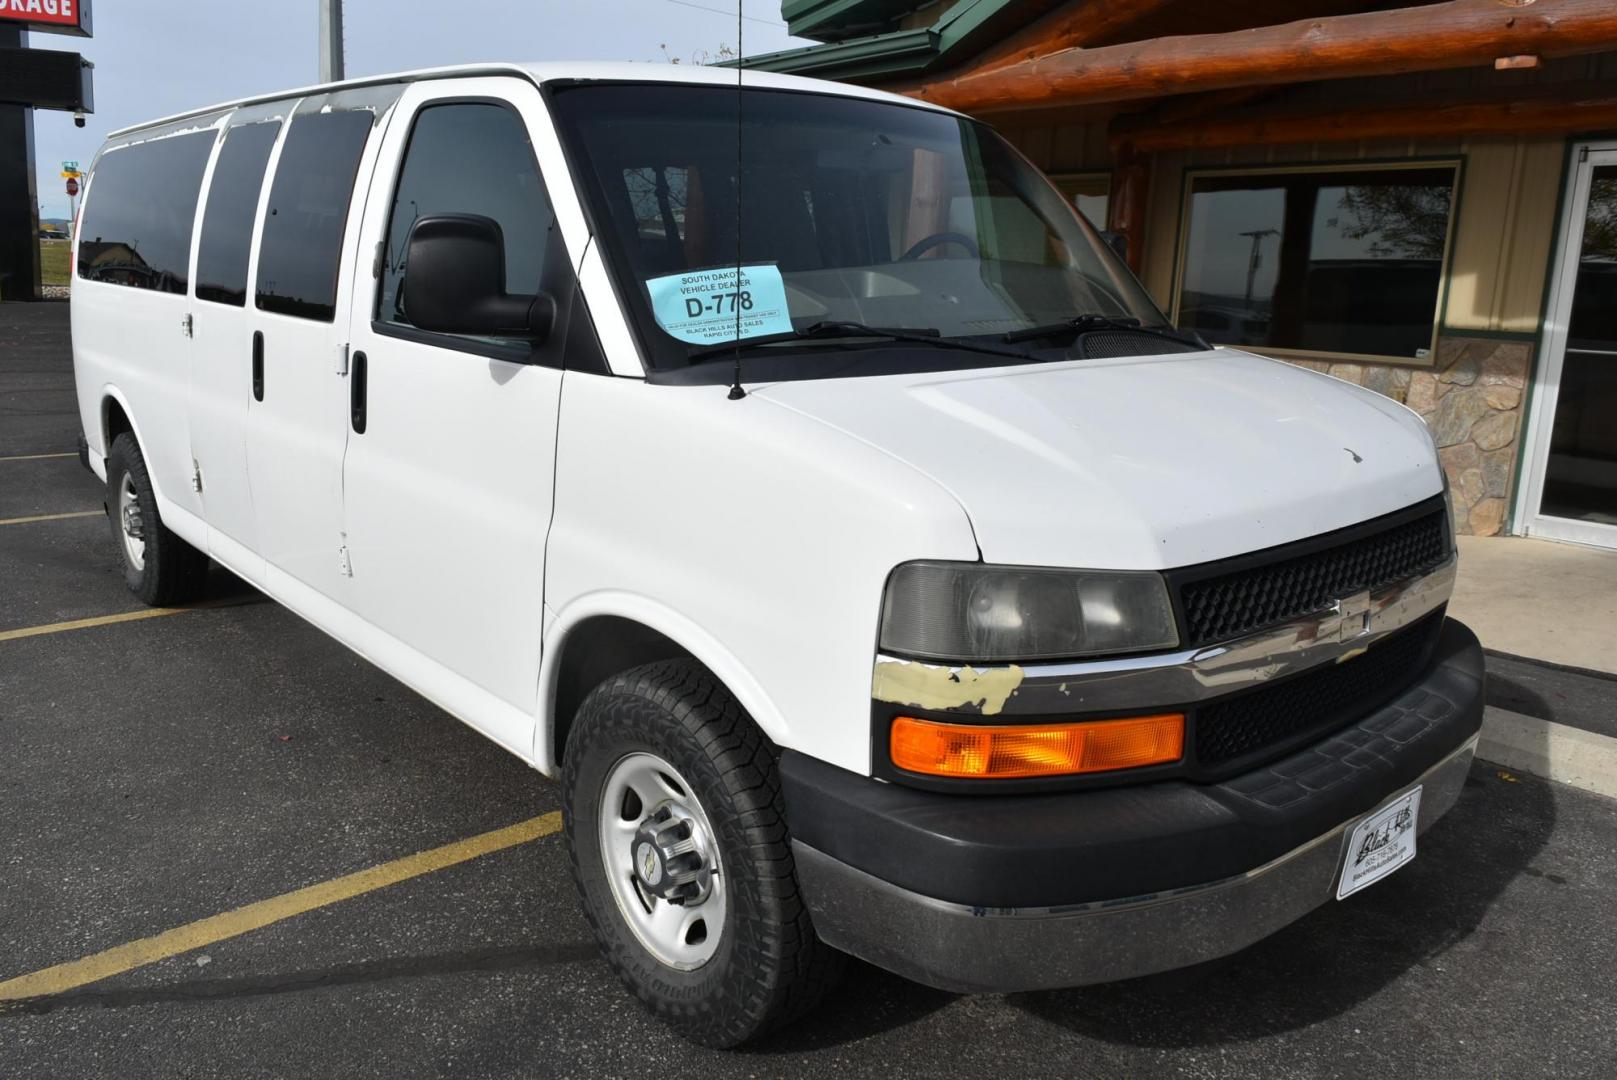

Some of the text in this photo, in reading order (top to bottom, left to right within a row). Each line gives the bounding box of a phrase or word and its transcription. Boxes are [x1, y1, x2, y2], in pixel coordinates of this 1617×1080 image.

[682, 271, 746, 285] SOUTH DAKOTA
[680, 279, 751, 295] VEHICLE DEALER
[685, 291, 753, 318] D-778
[726, 322, 743, 330] AUTO
[744, 319, 764, 328] SALES
